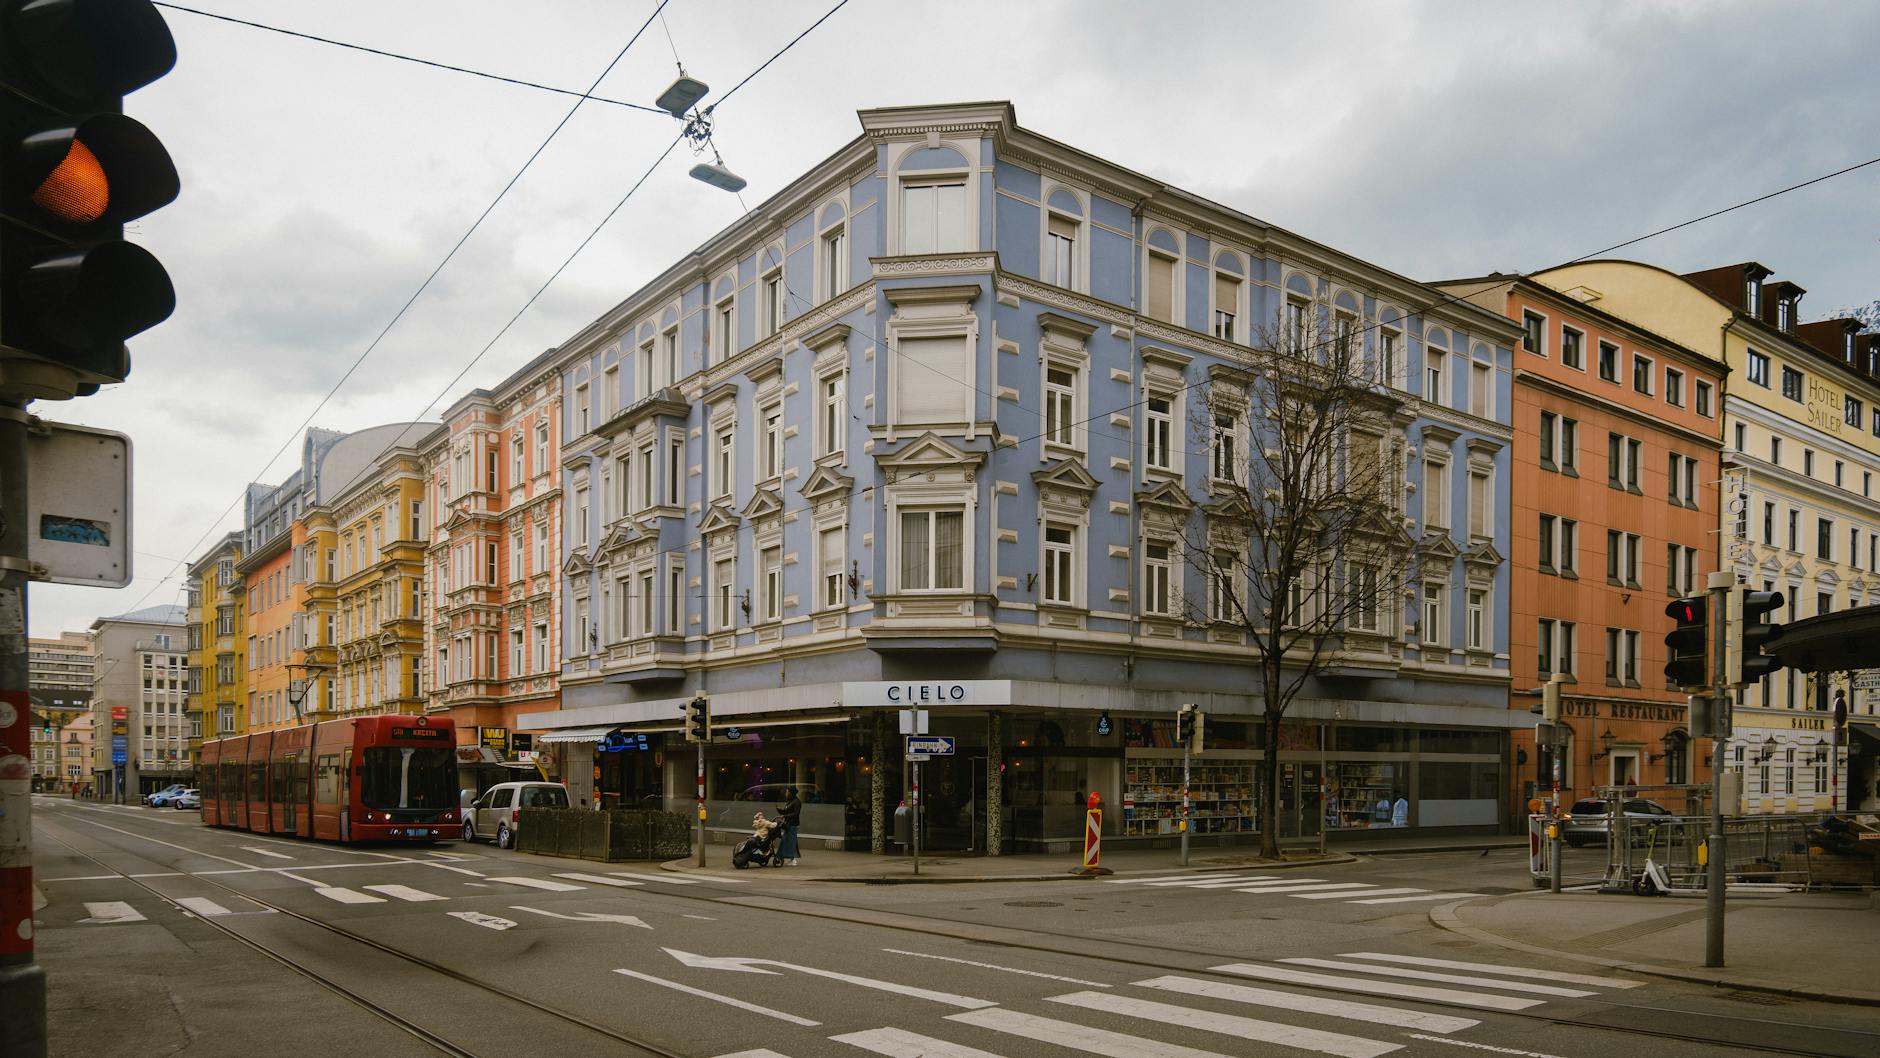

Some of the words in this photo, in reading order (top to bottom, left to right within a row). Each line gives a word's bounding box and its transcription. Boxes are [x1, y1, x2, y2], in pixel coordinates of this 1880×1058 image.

[1809, 377, 1841, 411] HOTEL
[1807, 402, 1842, 434] SAILER
[887, 685, 965, 701] CIELO
[1611, 703, 1685, 722] RESTAURANT
[1791, 717, 1825, 730] SAILER
